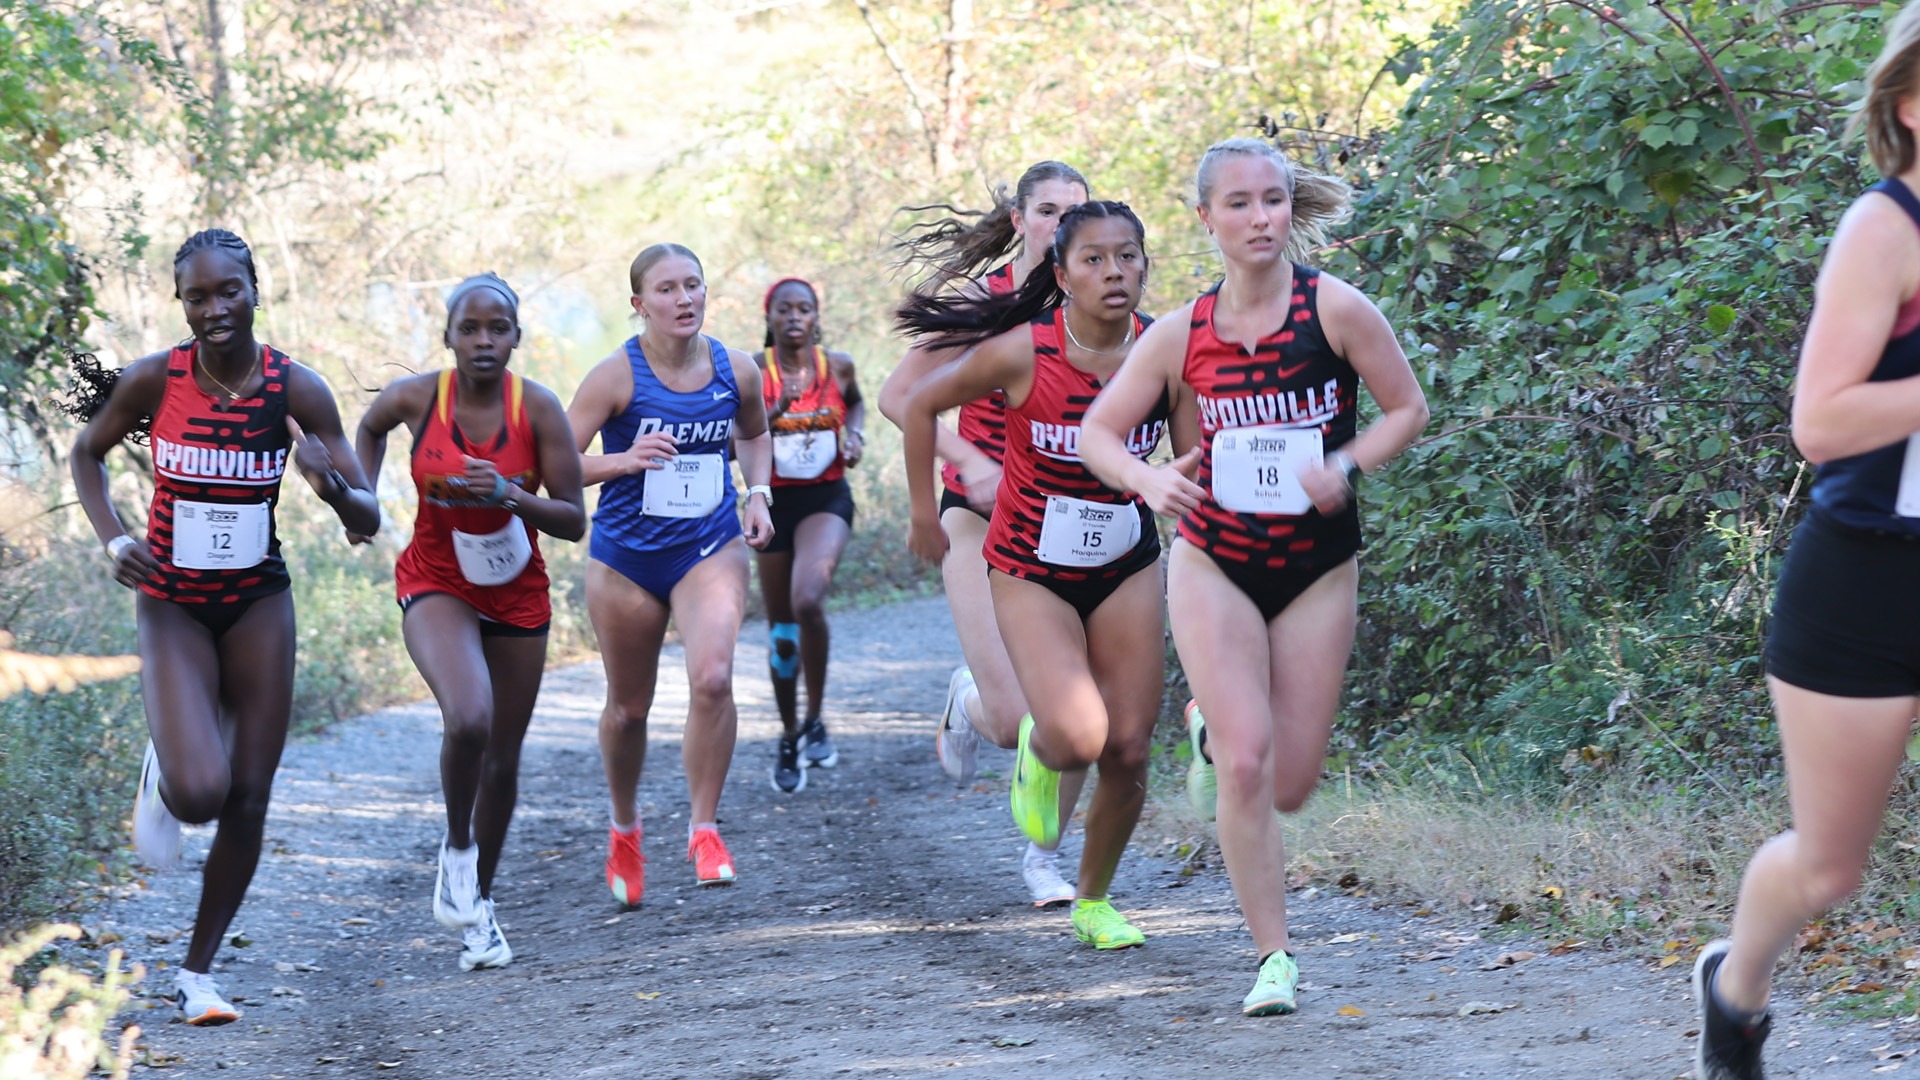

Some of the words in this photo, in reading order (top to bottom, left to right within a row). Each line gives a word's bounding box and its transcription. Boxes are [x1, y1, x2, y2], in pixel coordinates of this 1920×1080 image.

[1257, 465, 1279, 486] 18
[684, 483, 688, 498] 1
[1086, 508, 1114, 522] ECC
[212, 533, 231, 549] 12
[1083, 531, 1102, 547] 15
